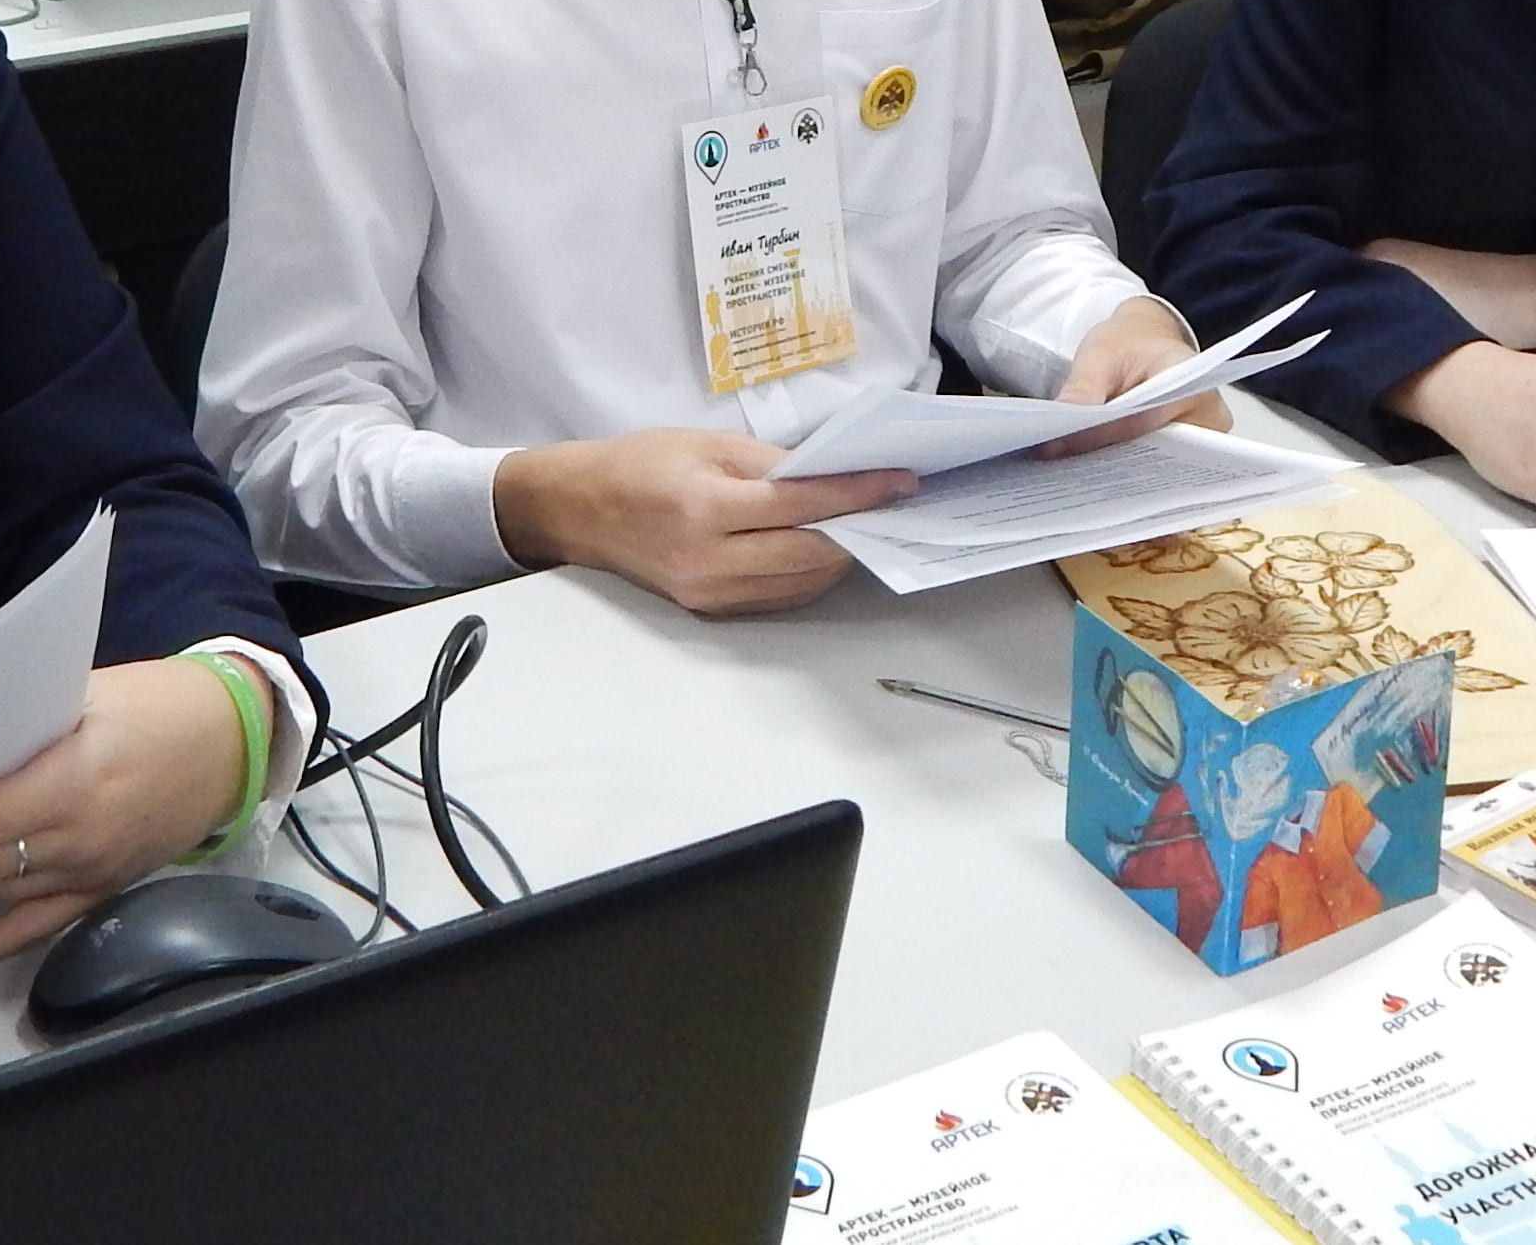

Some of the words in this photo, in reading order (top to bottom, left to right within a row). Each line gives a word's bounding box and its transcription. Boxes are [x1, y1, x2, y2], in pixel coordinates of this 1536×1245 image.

[748, 137, 782, 155] АРТЕК
[714, 189, 737, 202] АРТЕК
[748, 177, 787, 193] МУЗЕЙНОЕ
[715, 192, 771, 212] ПРОСТРАНСТВО
[720, 239, 753, 260] Иван
[757, 227, 801, 256] Турбин
[724, 267, 765, 287] УЧАСТНИК
[767, 259, 798, 275] СМЕНЫ
[763, 268, 806, 287] МУЗЕЙНОЕ
[1381, 997, 1447, 1035] АРТЕК
[1309, 1087, 1355, 1110] АРТЕК
[1370, 1050, 1446, 1087] МУЗЕЙНОЕ
[1319, 1074, 1427, 1121] ПРОСТРАНСТВО
[930, 1118, 1002, 1154] АРТЕК
[837, 1208, 889, 1234] АРТЕК
[908, 1171, 991, 1209] МУЗЕЙНОЕ
[846, 1197, 966, 1245] ПРОСТРАНСТВО
